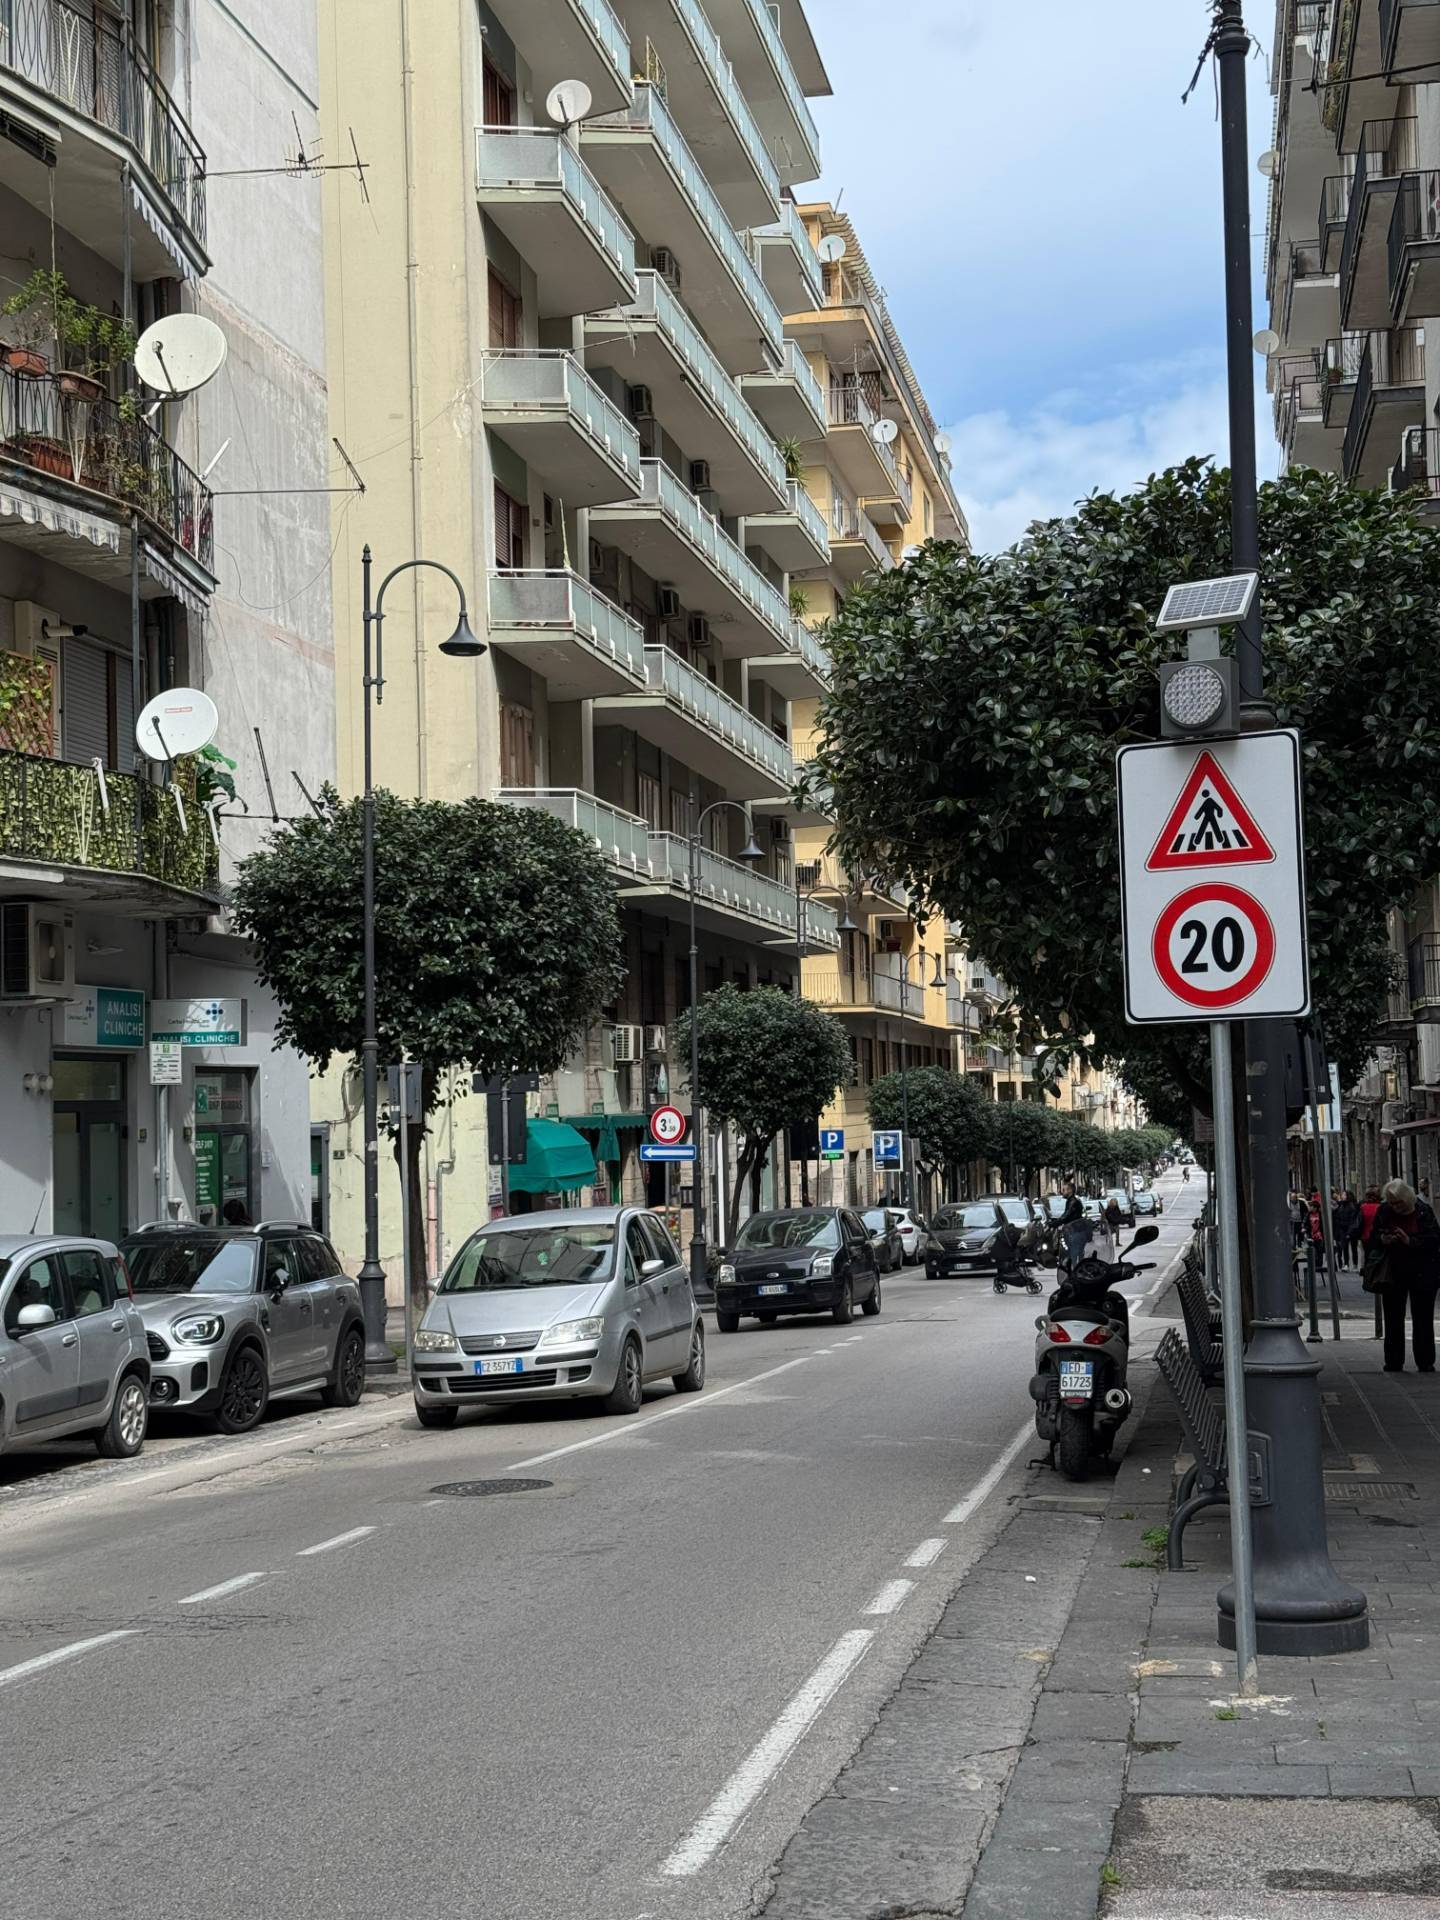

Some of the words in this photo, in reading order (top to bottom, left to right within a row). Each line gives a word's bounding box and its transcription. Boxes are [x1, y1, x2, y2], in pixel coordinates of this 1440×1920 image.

[1180, 916, 1245, 973] 20
[107, 1001, 141, 1017] ANALISI
[104, 1021, 144, 1036] CLINICHE
[195, 1034, 236, 1043] CLINICHE
[827, 1132, 838, 1148] P
[880, 1135, 894, 1155] P
[1062, 1376, 1091, 1388] 61723
